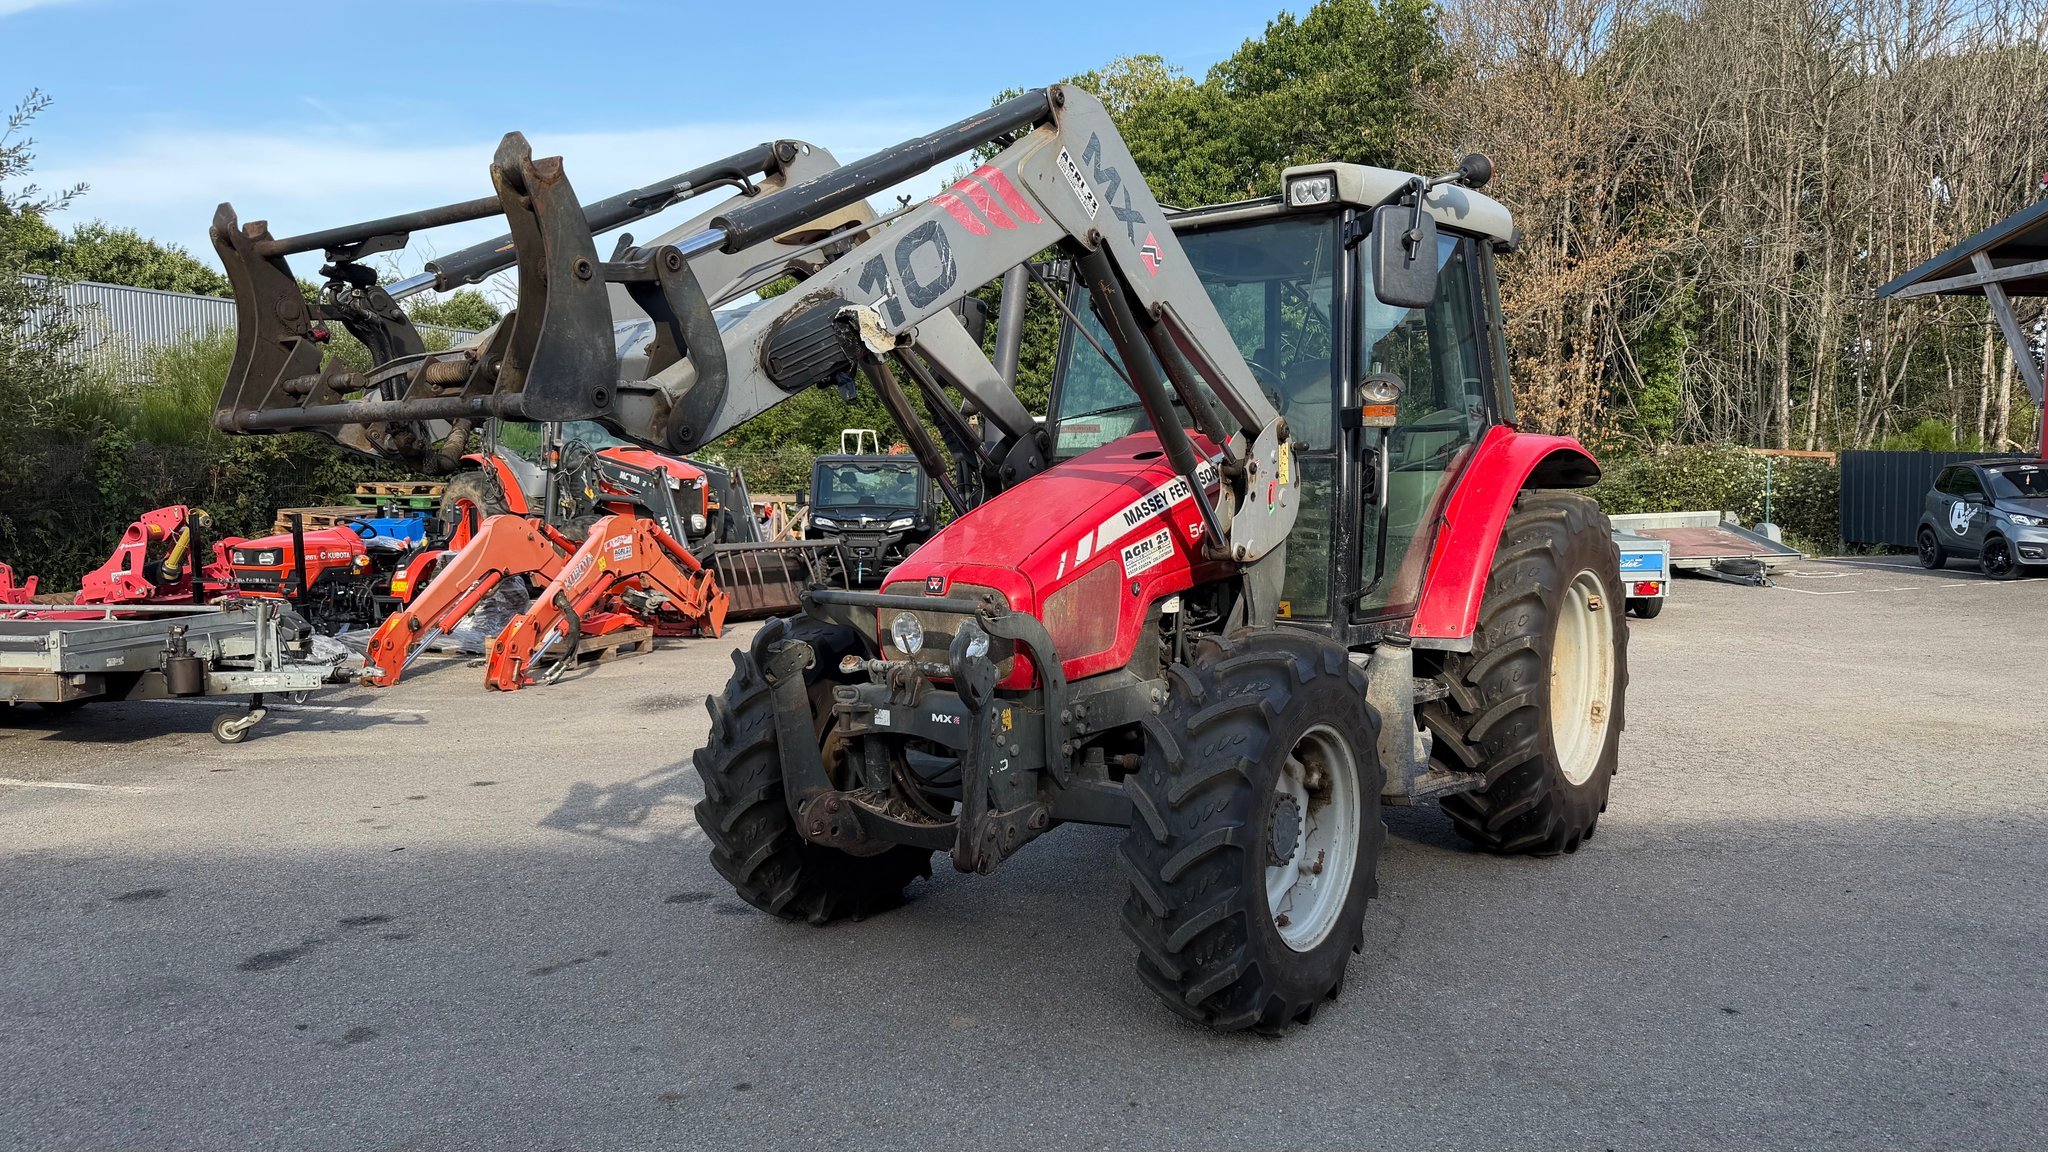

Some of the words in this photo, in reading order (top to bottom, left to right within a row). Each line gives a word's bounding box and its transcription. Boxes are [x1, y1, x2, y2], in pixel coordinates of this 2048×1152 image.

[1061, 151, 1085, 189] AGRI
[1086, 192, 1098, 211] 23
[1082, 131, 1146, 247] MX
[857, 220, 957, 328] 10
[1123, 491, 1169, 527] MASSEY
[1169, 465, 1219, 501] FERSON
[564, 552, 594, 590] KUBOTA
[1124, 539, 1154, 562] AGRI
[1156, 531, 1169, 545] 23
[1620, 557, 1643, 568] ider
[931, 713, 952, 724] MX
